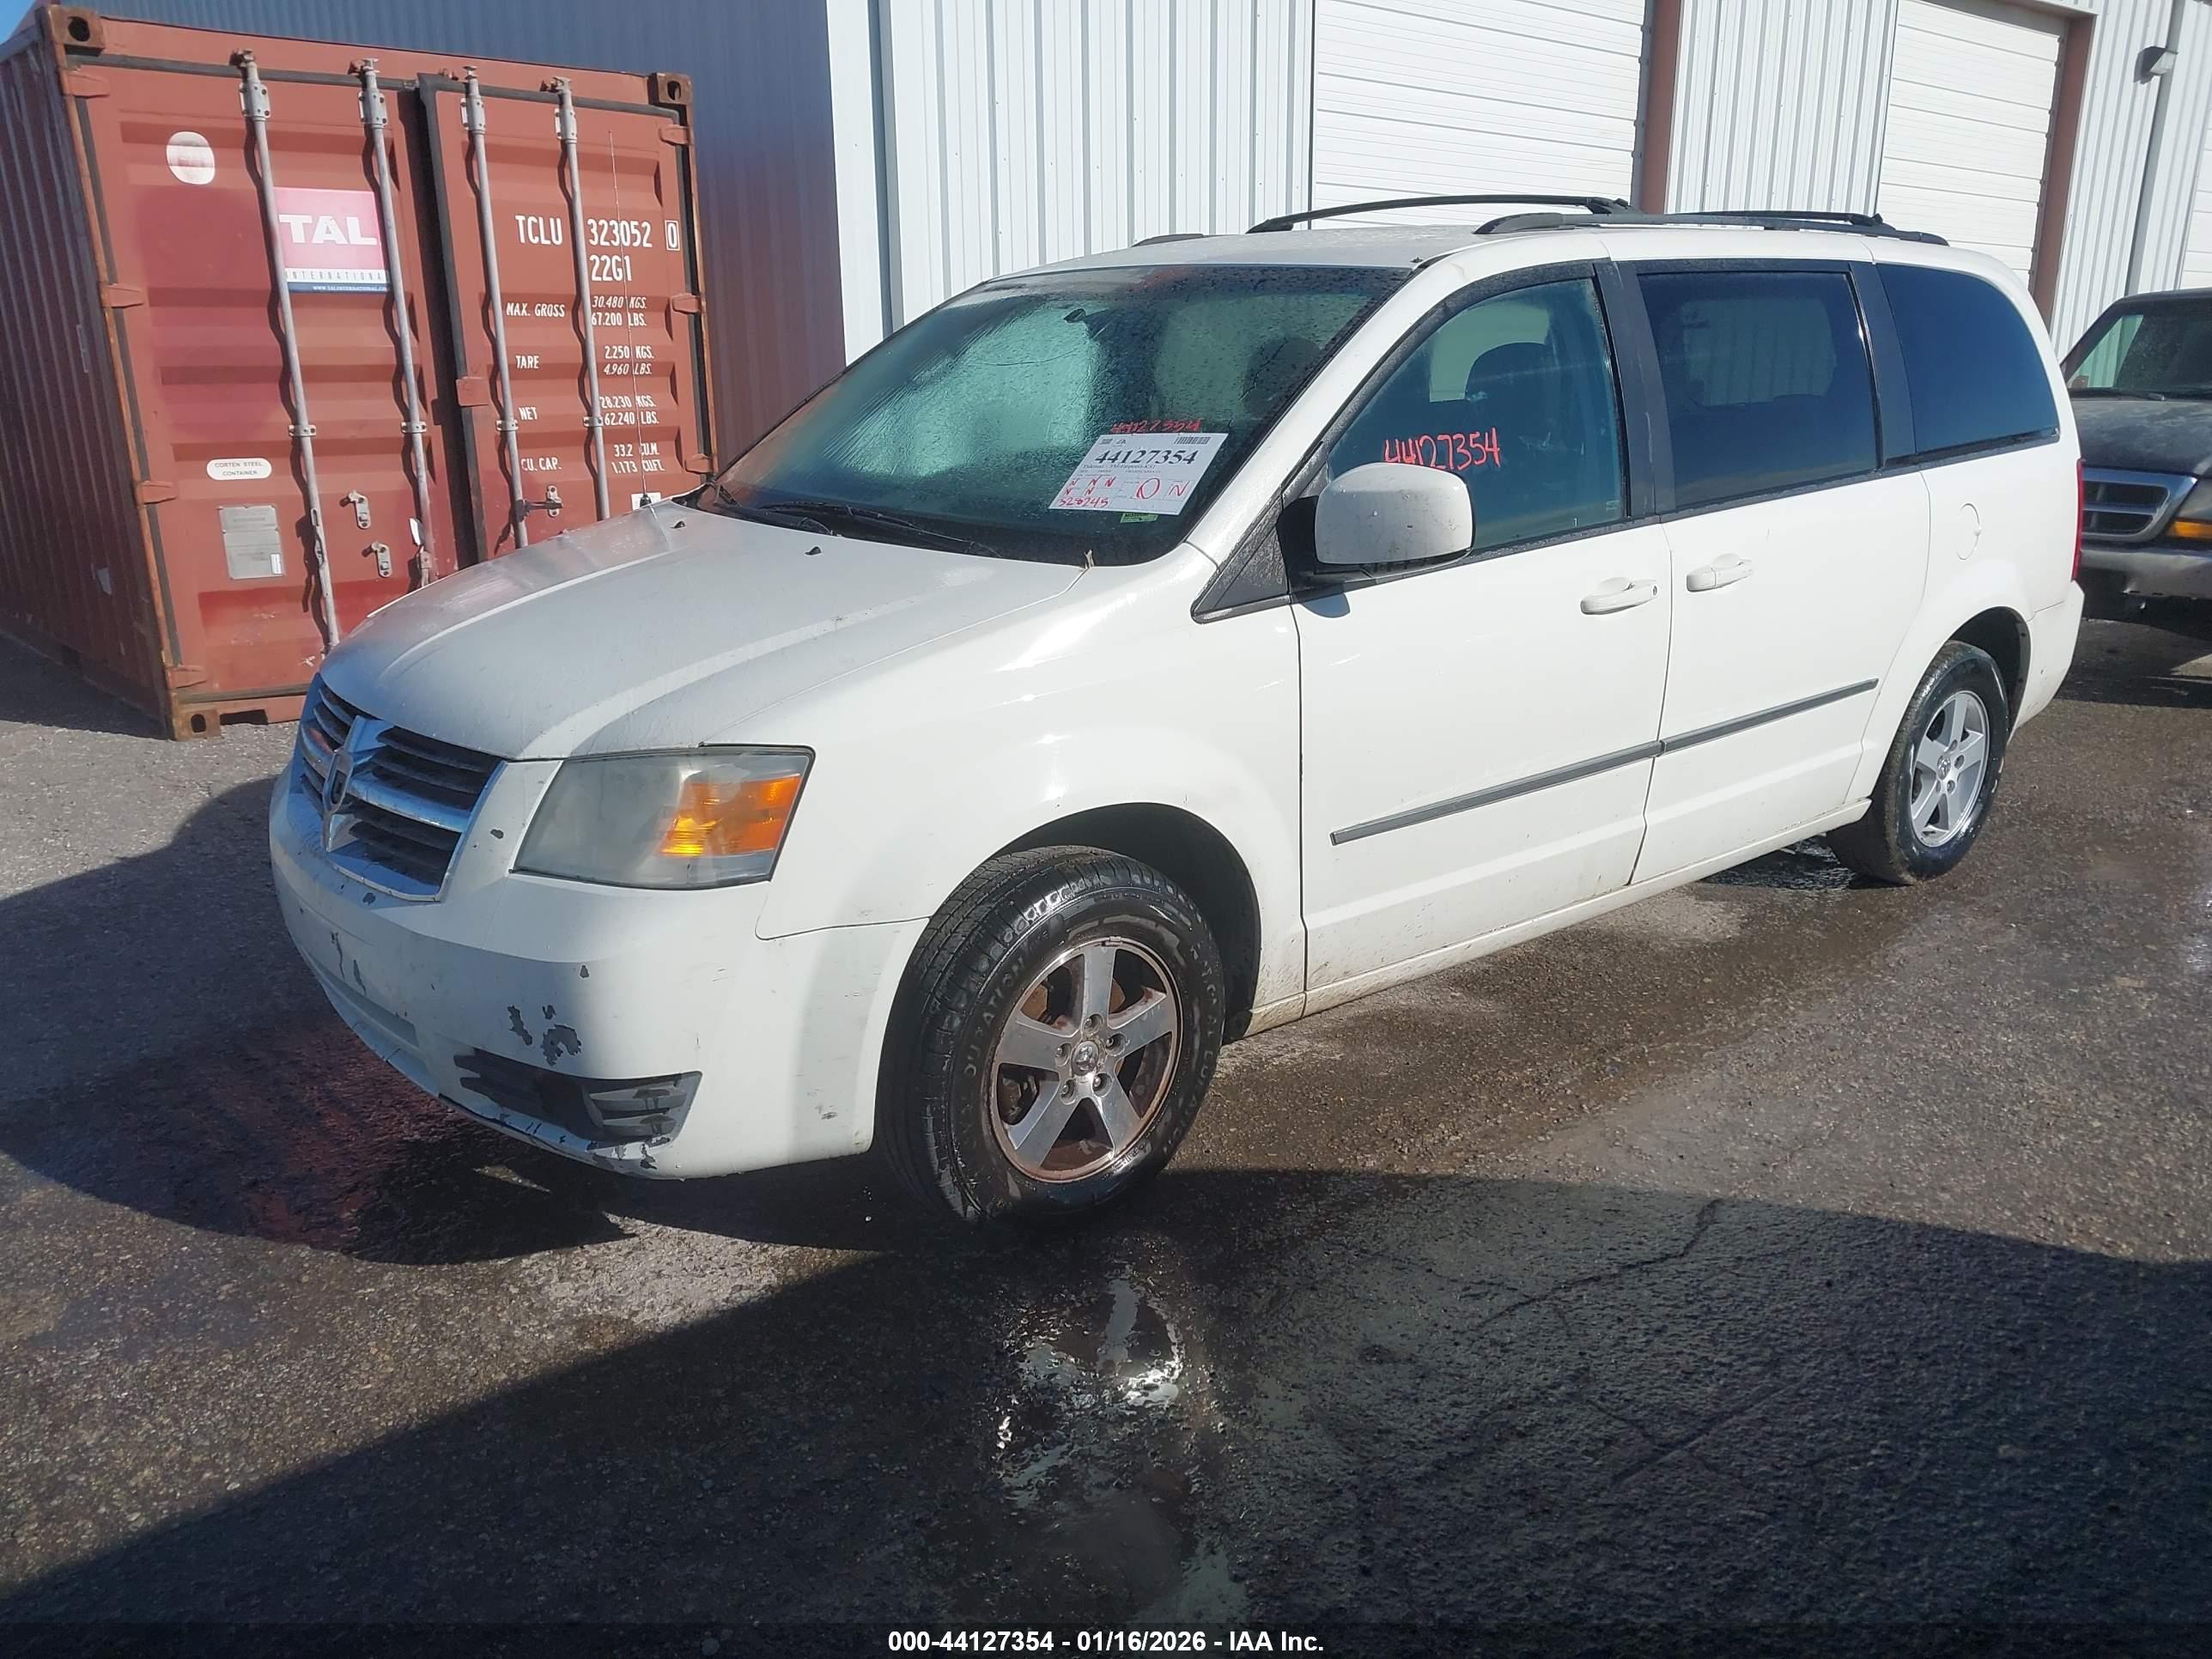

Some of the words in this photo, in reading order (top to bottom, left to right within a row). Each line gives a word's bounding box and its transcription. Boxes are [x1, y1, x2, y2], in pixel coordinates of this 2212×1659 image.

[278, 214, 378, 246] TAL
[514, 216, 563, 245] TCLU
[587, 218, 653, 247] 323052
[590, 254, 632, 282] 22G1
[592, 295, 624, 308] 30.480
[629, 296, 647, 309] KGS.
[506, 303, 531, 317] MAX.
[534, 304, 565, 318] GROSS
[591, 312, 623, 325] 67.200
[628, 313, 647, 326] LBS.
[605, 345, 630, 359] 2.250
[635, 345, 654, 359] KGS.
[516, 355, 539, 369] TARE
[604, 362, 629, 375] 4.960
[634, 362, 653, 375] LBS.
[599, 396, 632, 409] 28.230
[635, 395, 658, 407] KGS.
[519, 407, 538, 420] NET
[605, 412, 635, 426] 62.240
[641, 411, 659, 424] LBS.
[613, 443, 634, 457] 33.2
[1384, 428, 1500, 471] 44127354
[520, 458, 538, 471] CU.
[538, 457, 562, 471] CAP.
[1095, 449, 1199, 465] 44127354
[611, 460, 638, 474] 1.173
